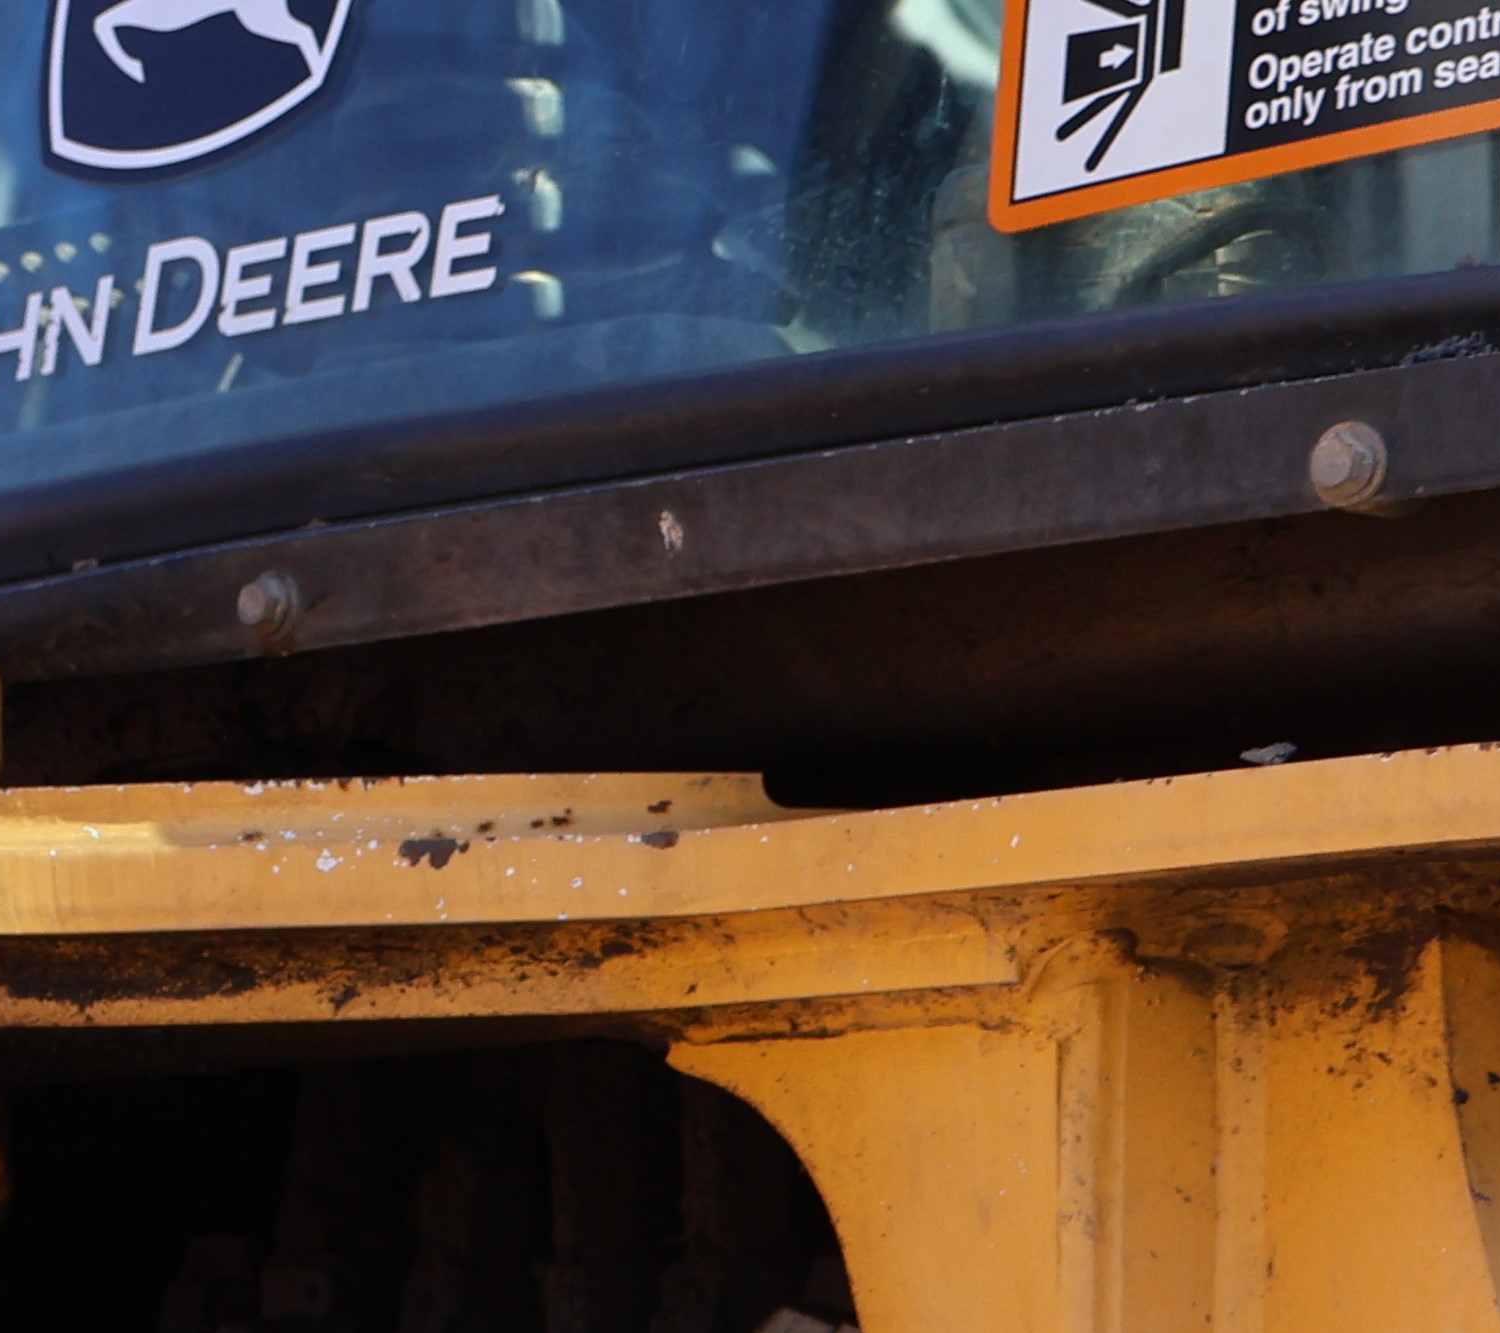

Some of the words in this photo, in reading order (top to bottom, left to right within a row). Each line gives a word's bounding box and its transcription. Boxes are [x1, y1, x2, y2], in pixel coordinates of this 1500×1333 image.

[1252, 0, 1290, 36] of
[1248, 33, 1396, 93] Operate
[1245, 85, 1325, 129] only
[1334, 67, 1424, 110] from
[132, 194, 505, 356] DEERE
